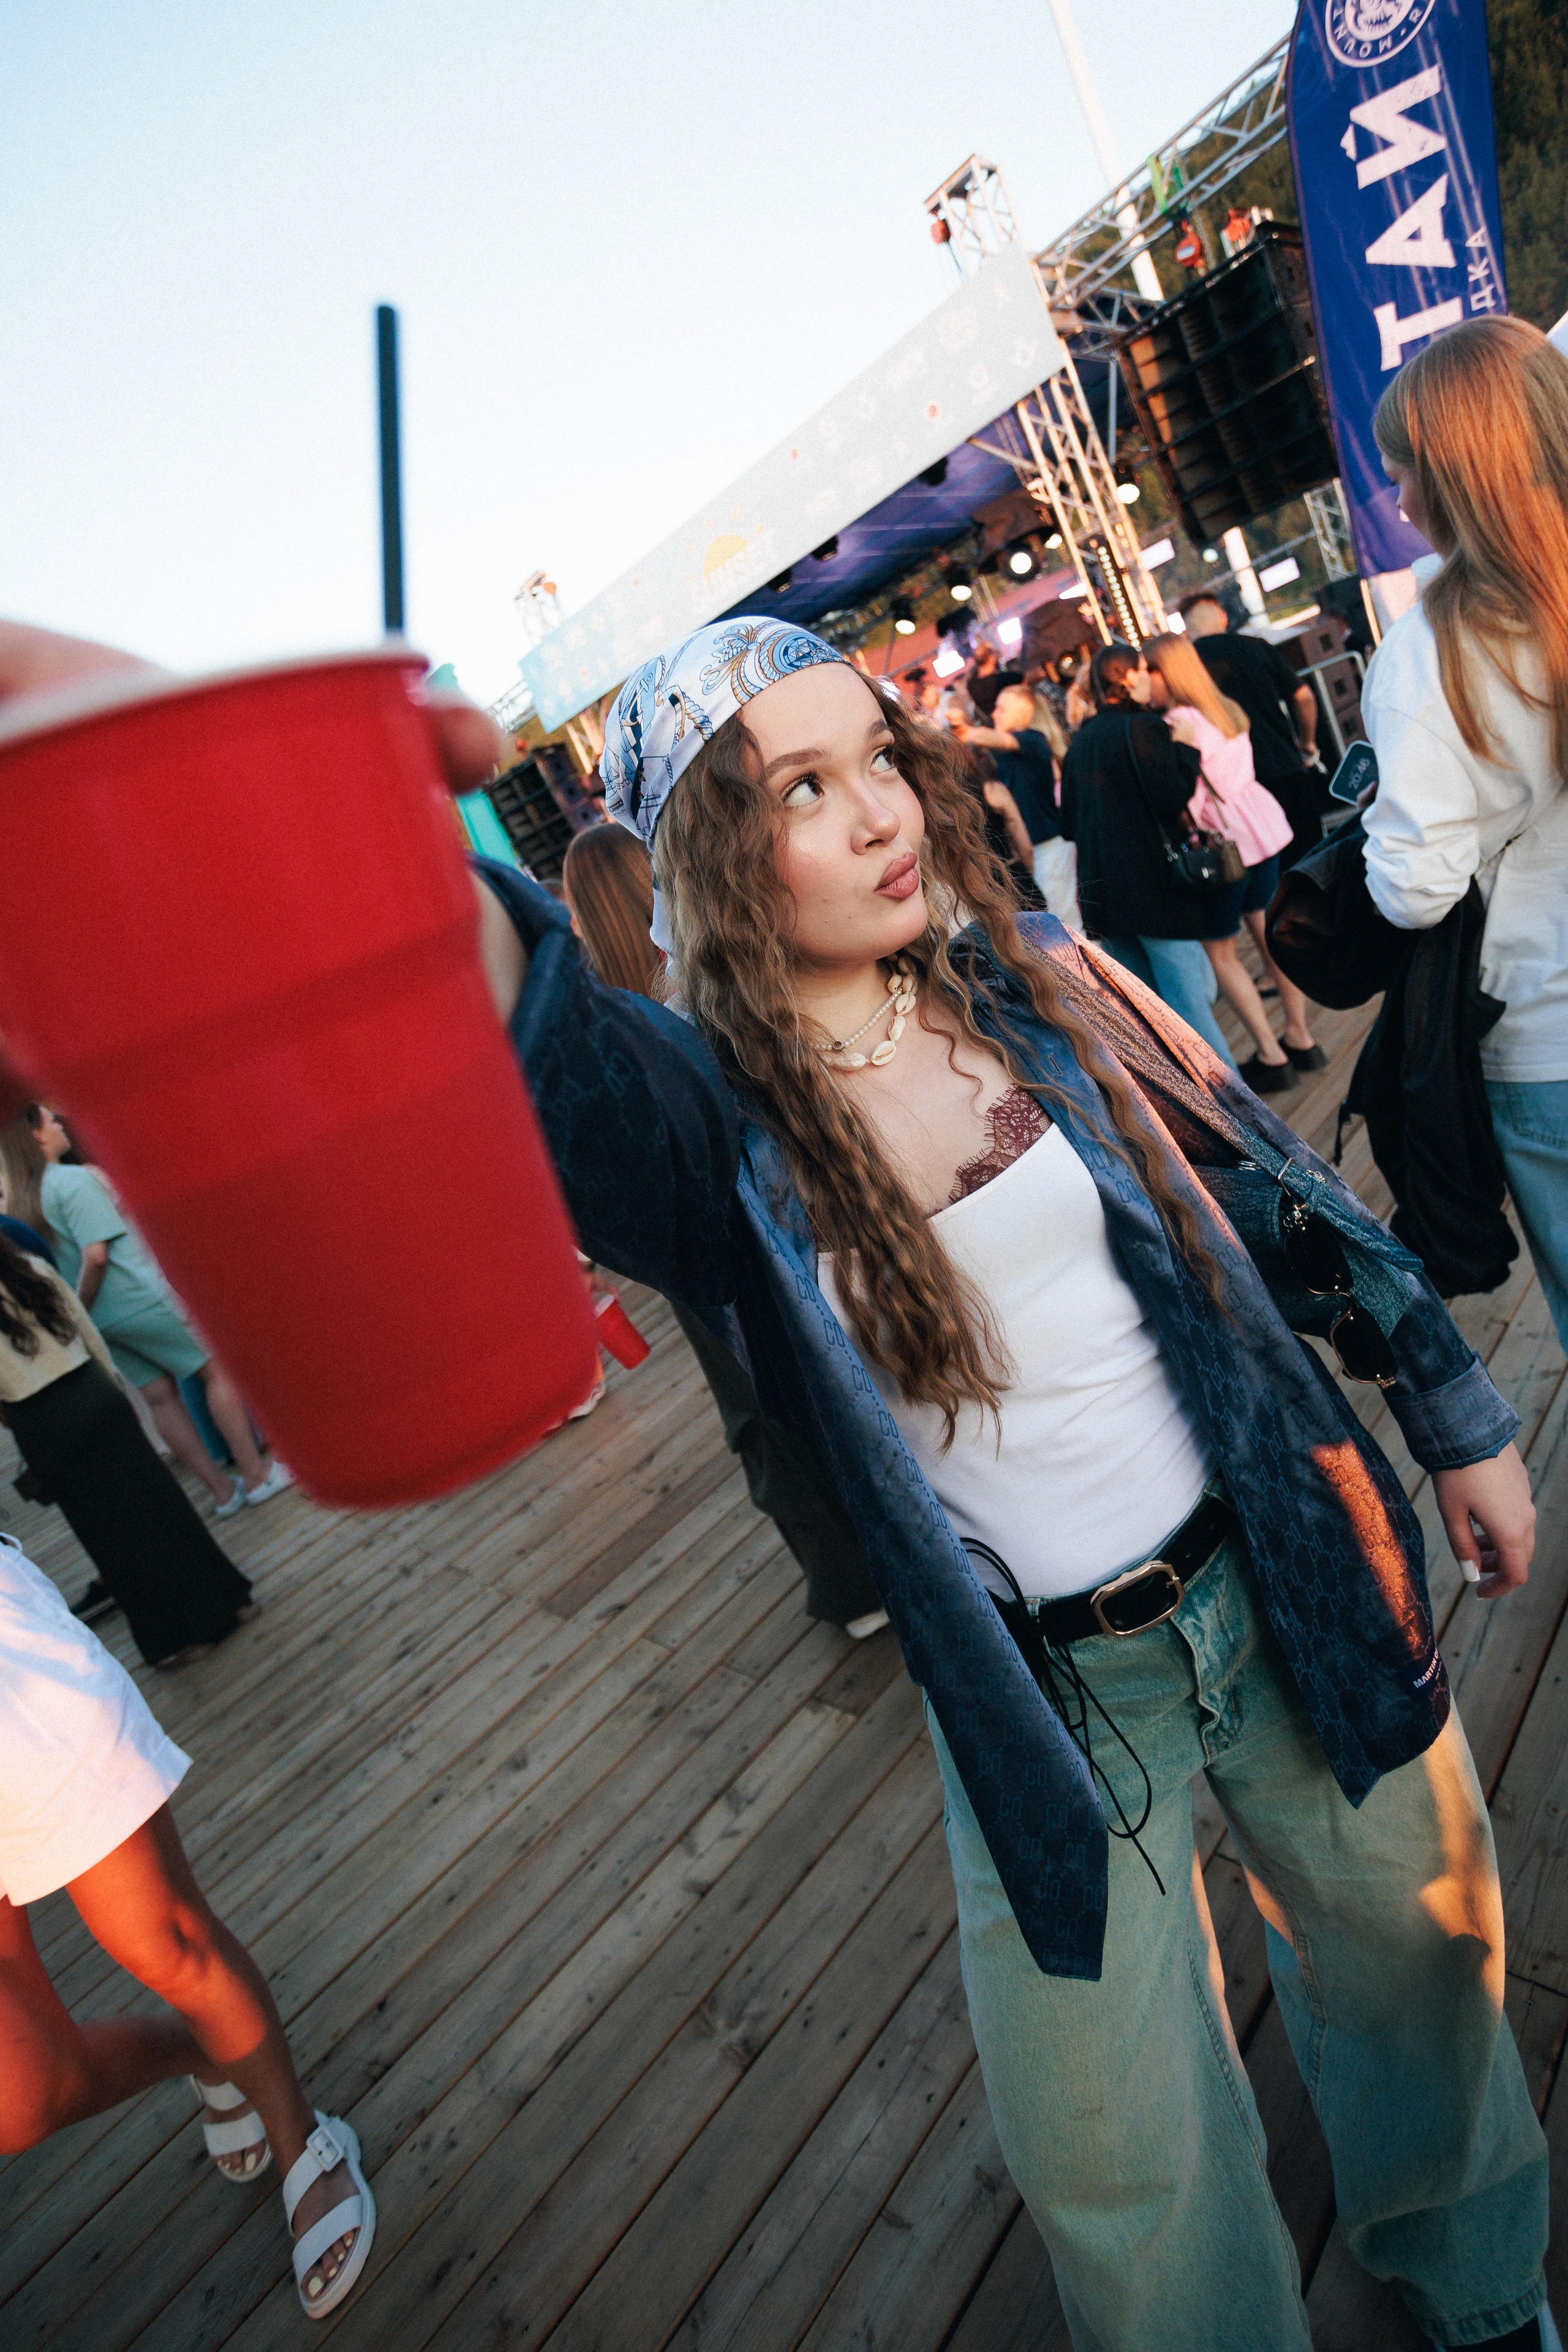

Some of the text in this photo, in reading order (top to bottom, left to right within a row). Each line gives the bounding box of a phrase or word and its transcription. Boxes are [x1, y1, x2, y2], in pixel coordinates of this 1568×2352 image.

[1340, 64, 1464, 371] ТАЙ
[1465, 225, 1496, 311] ДКА
[1413, 1657, 1437, 1688] MARTIN
